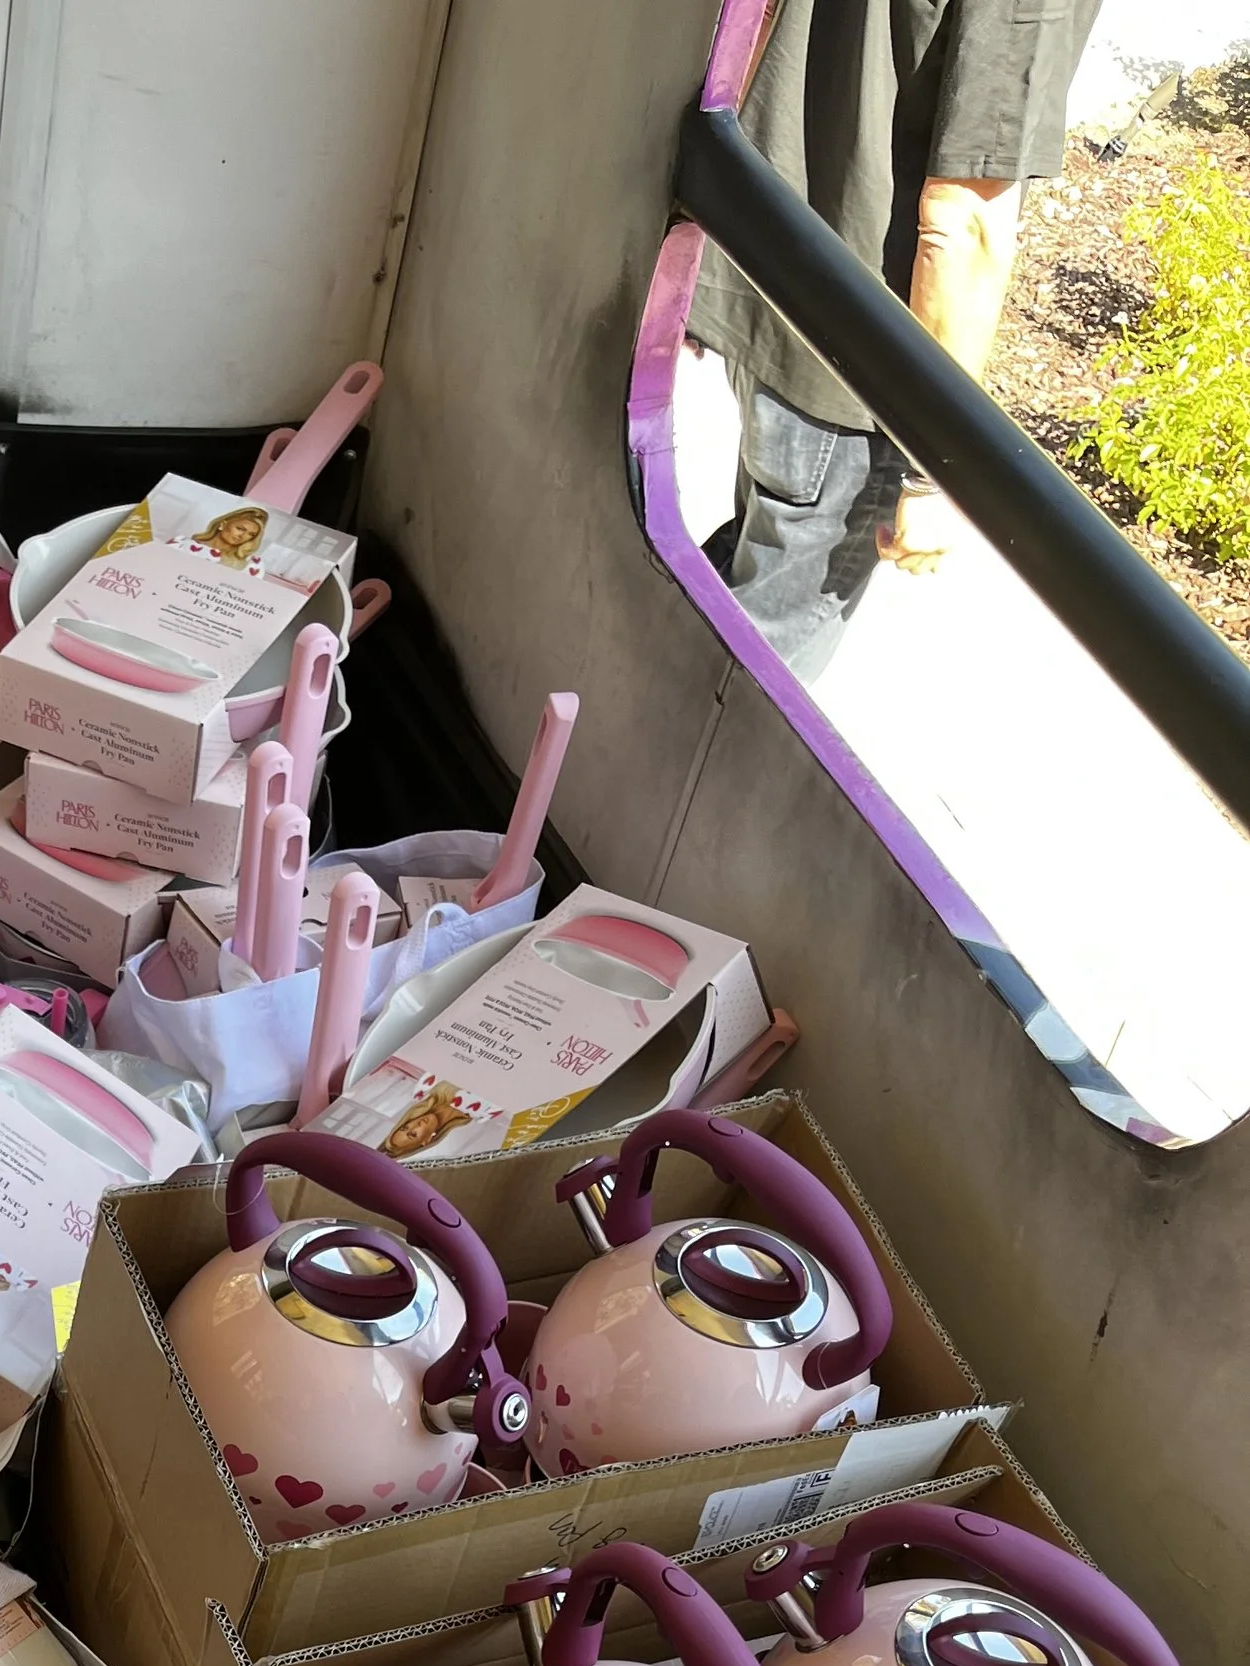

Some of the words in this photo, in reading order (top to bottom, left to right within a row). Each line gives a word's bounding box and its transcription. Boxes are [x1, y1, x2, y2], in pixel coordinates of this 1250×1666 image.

[88, 575, 142, 600] HILTON
[101, 566, 145, 589] PARIS
[175, 583, 201, 597] Cast
[205, 594, 264, 619] Aluminum
[177, 574, 223, 595] Ceramic
[226, 591, 276, 615] Nonstick
[193, 598, 210, 610] Fry
[214, 606, 235, 618] Pan
[24, 709, 64, 735] HILTON
[29, 698, 62, 721] PARIS
[79, 718, 117, 739] Ceramic
[118, 730, 160, 754] Nonstick
[81, 729, 101, 744] Cast
[104, 738, 155, 762] Aluminum
[101, 746, 116, 760] Fry
[118, 752, 135, 765] Pan
[56, 811, 99, 832] HILTON
[61, 800, 95, 818] PARIS
[114, 813, 154, 830] Ceramic
[157, 823, 200, 840] Nonstick
[117, 824, 139, 837] Cast
[143, 829, 194, 847] Aluminum
[138, 838, 153, 850] Fry
[156, 841, 174, 853] Pan
[450, 1021, 499, 1049] Aluminum
[478, 1020, 497, 1034] Pan
[434, 1028, 474, 1054] Nonstick
[500, 1044, 523, 1060] Cast
[560, 1034, 614, 1065] HILTON
[475, 1049, 515, 1072] Ceramic
[550, 1050, 594, 1077] PARIS
[2, 1191, 29, 1217] Cast
[62, 1200, 96, 1232] TON
[59, 1216, 92, 1248] RIS
